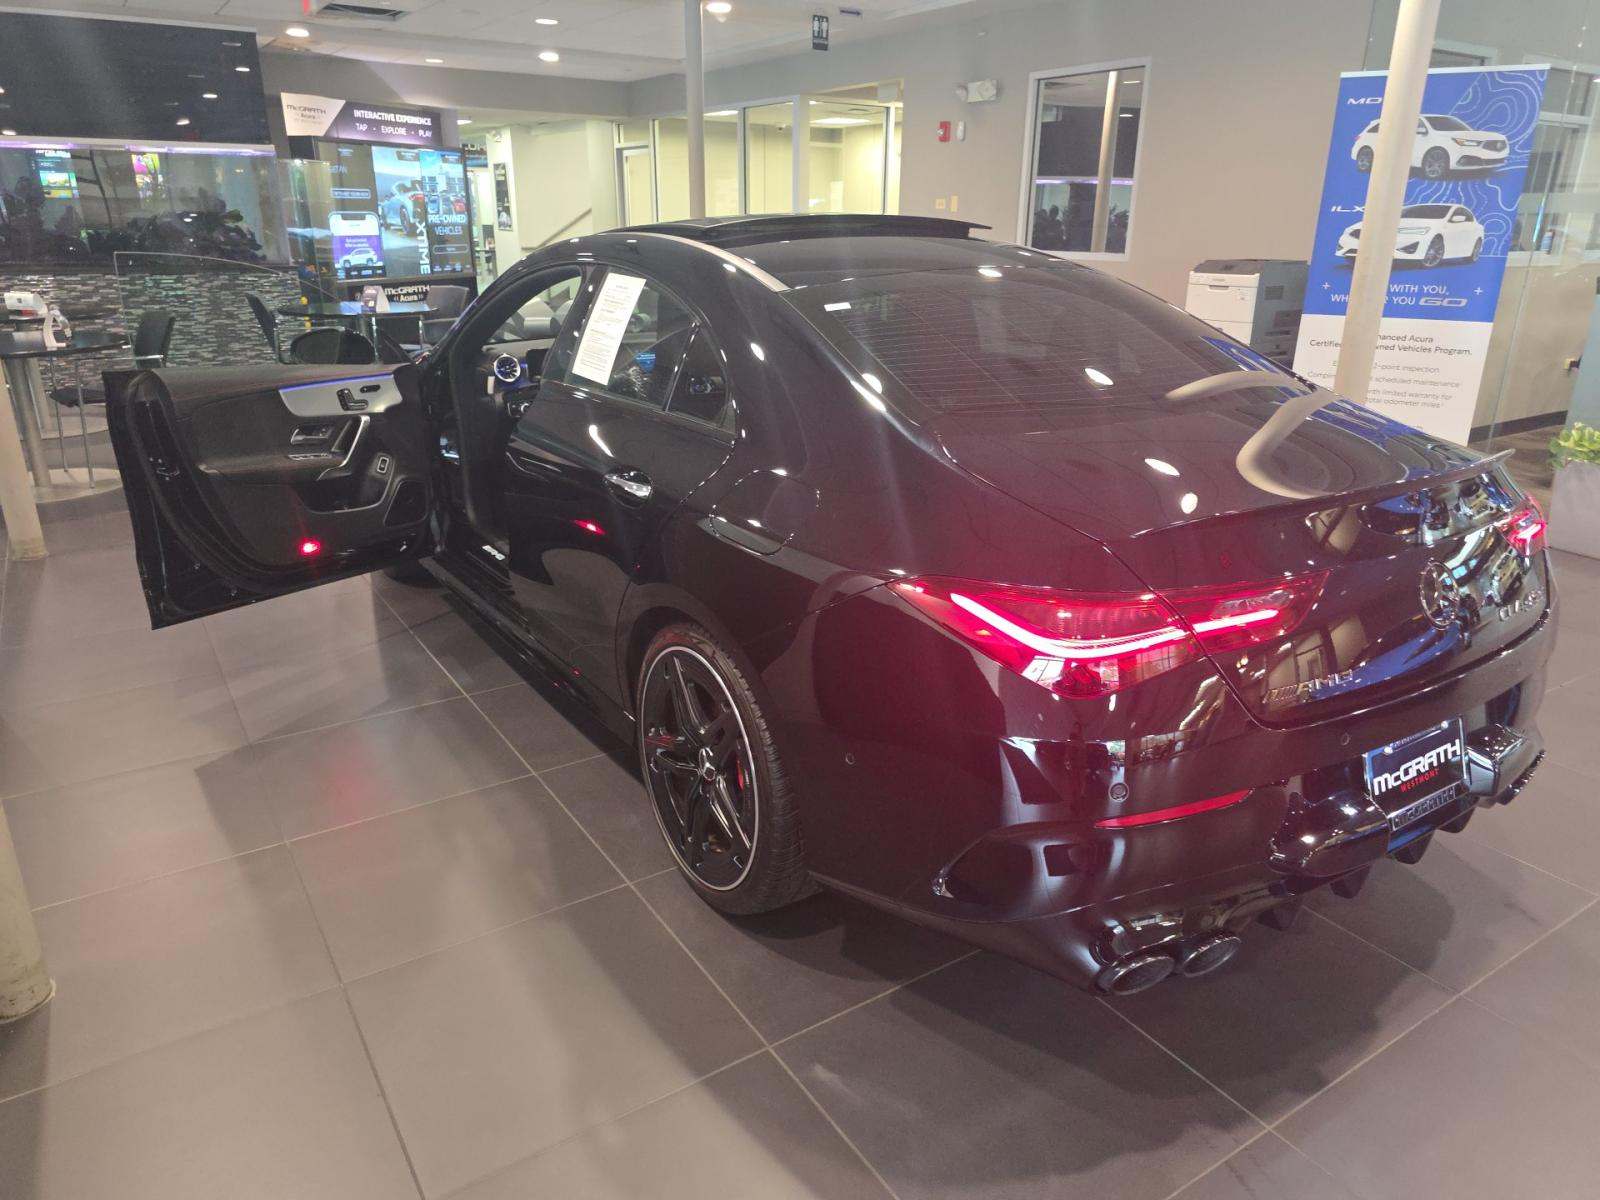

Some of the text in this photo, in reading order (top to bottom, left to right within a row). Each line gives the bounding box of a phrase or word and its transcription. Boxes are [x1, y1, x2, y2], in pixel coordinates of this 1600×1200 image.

[1347, 97, 1382, 105] MD
[354, 109, 432, 125] INTERACTIVE EXPERIENCE
[355, 123, 368, 131] TAP
[381, 126, 407, 135] EXPLORE
[1390, 284, 1418, 293] WITH
[1392, 296, 1416, 305] YOU
[1419, 297, 1468, 307] GO
[1409, 335, 1434, 343] Acura
[1309, 339, 1342, 347] Certifie
[1397, 344, 1432, 353] Vehicles
[1373, 738, 1461, 796] McGRATH
[1400, 768, 1441, 793] WESTMONT
